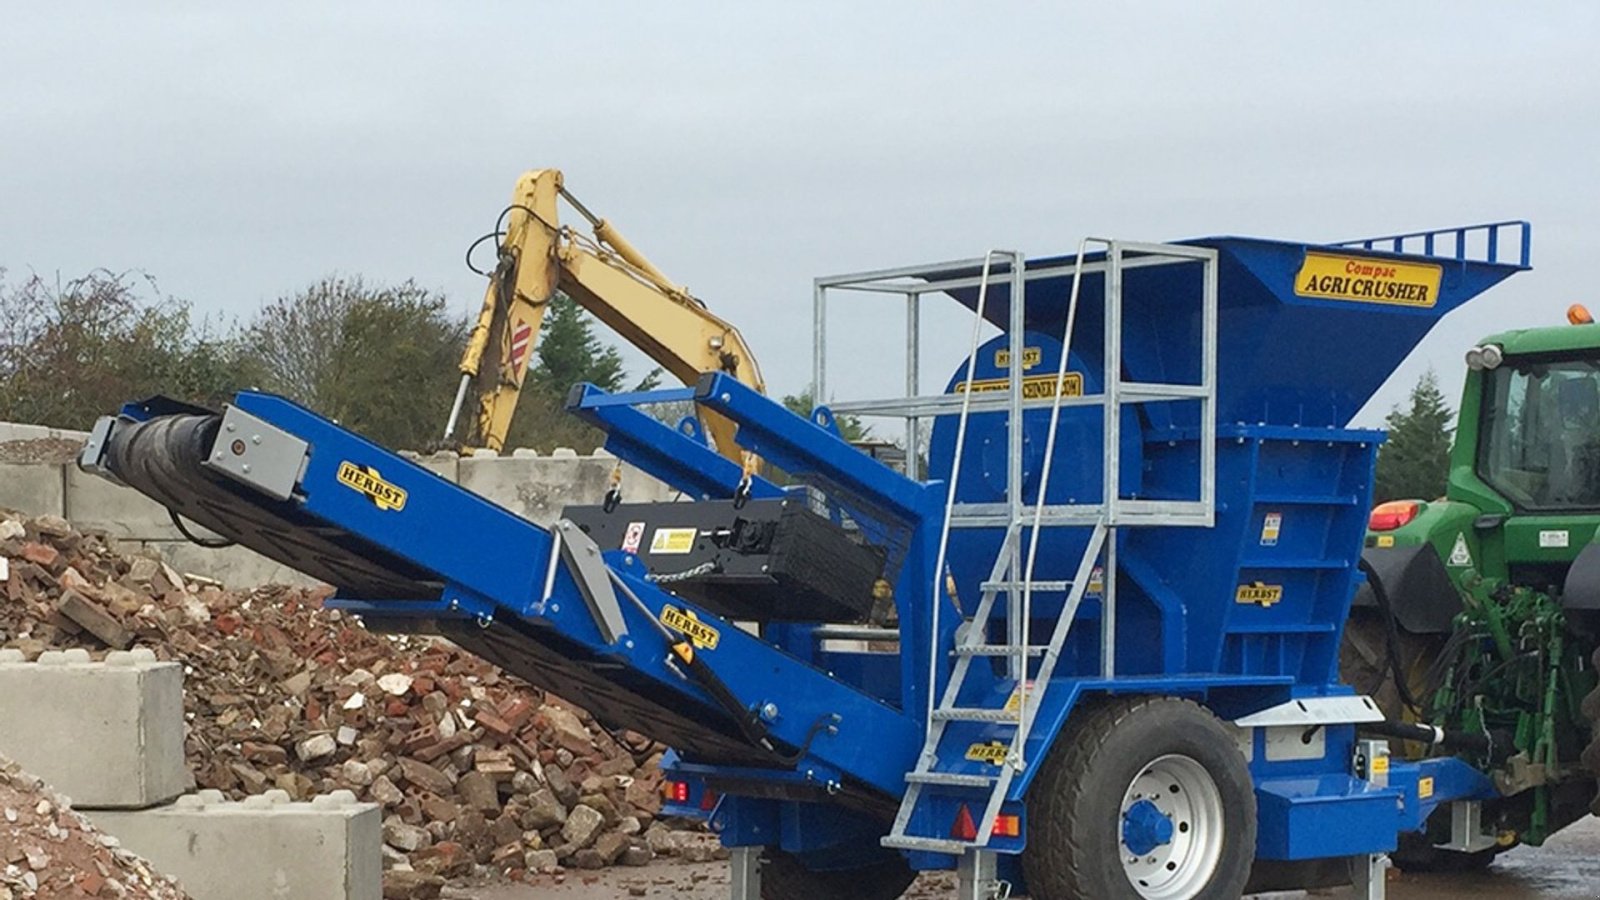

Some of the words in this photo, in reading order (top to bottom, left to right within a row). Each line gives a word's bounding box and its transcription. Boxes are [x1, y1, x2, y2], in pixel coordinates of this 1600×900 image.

[1345, 261, 1397, 279] Compac
[1305, 274, 1351, 295] AGRI
[1351, 278, 1429, 302] CRUSHER
[342, 467, 402, 504] HERBST
[1239, 589, 1279, 599] HERBST
[665, 610, 716, 643] HERBST
